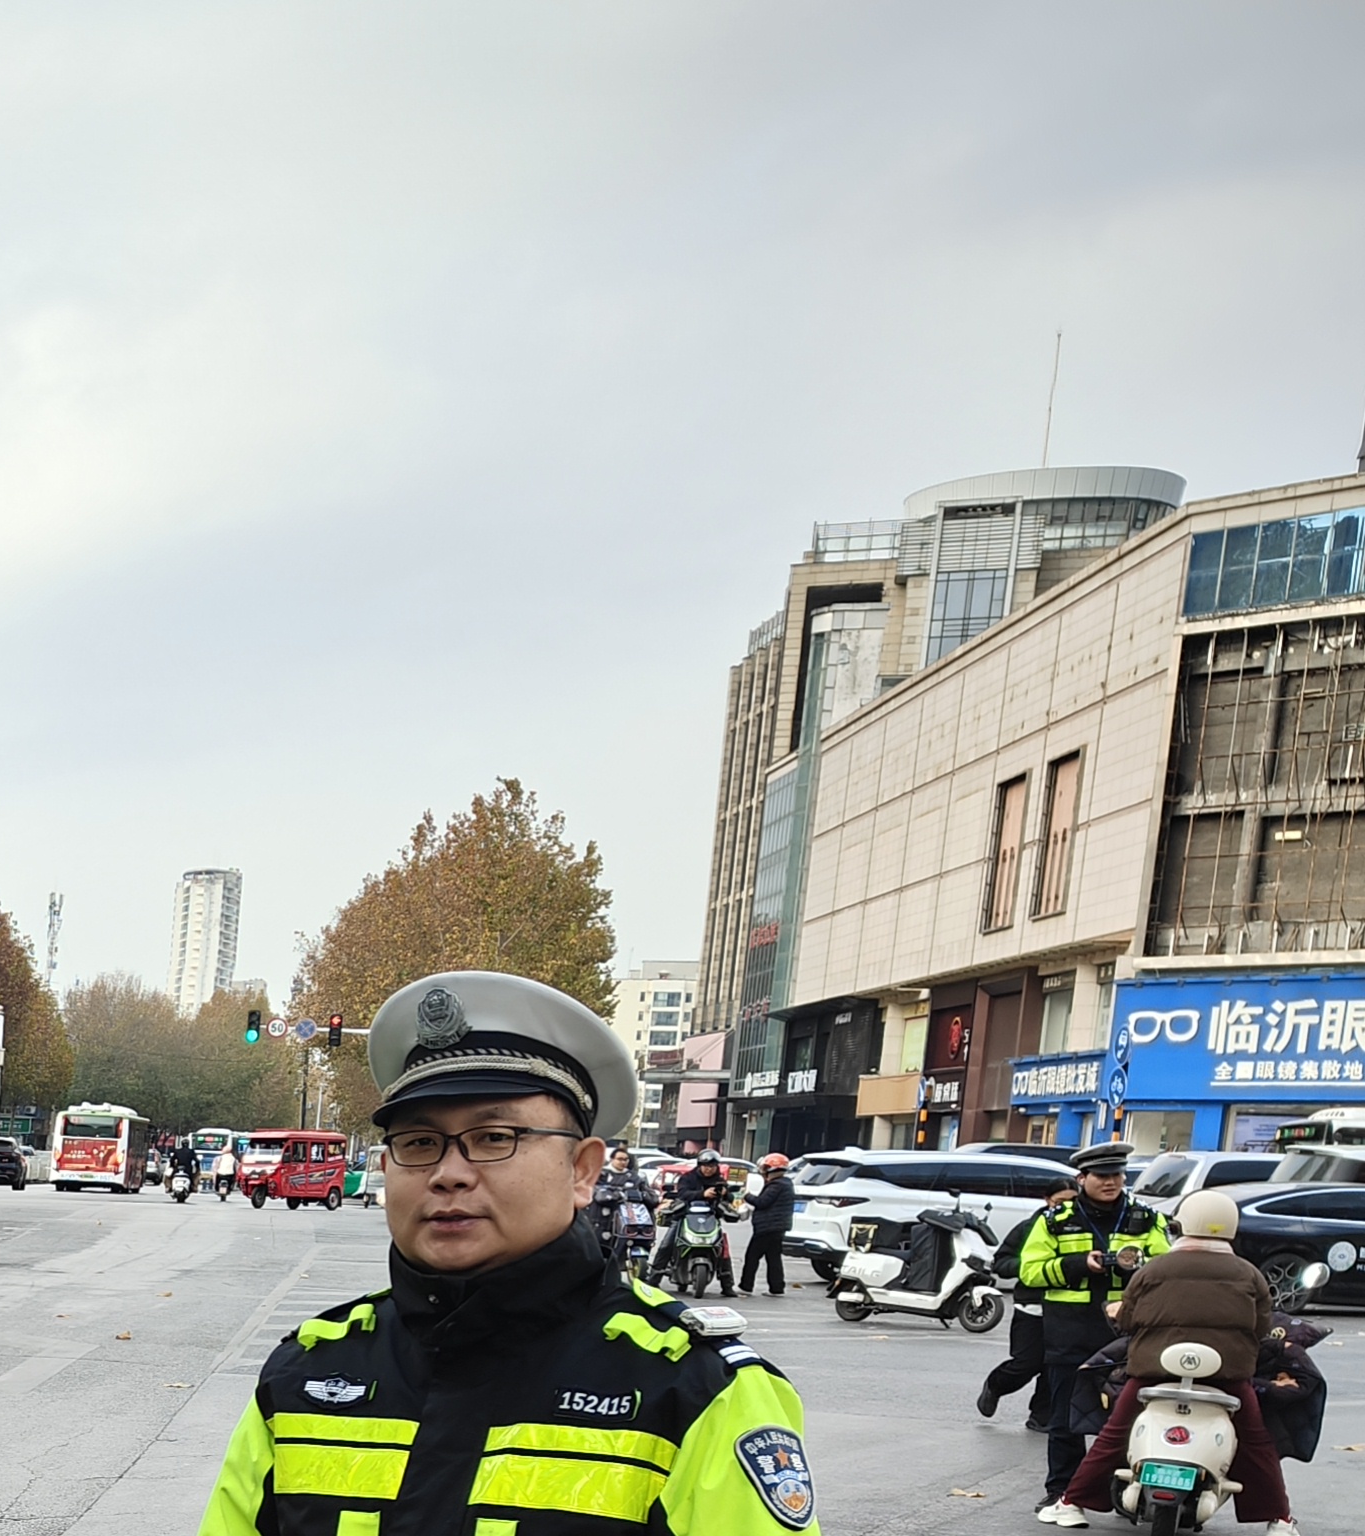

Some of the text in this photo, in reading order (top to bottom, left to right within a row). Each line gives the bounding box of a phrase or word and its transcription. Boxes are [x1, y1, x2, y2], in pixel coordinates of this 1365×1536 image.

[270, 1021, 284, 1033] 50
[1207, 999, 1365, 1055] 临沂眼
[1028, 1062, 1100, 1098] 临沂眼镜批发城
[1214, 1060, 1364, 1081] 全国眼镜集散地
[558, 1391, 632, 1415] 152415
